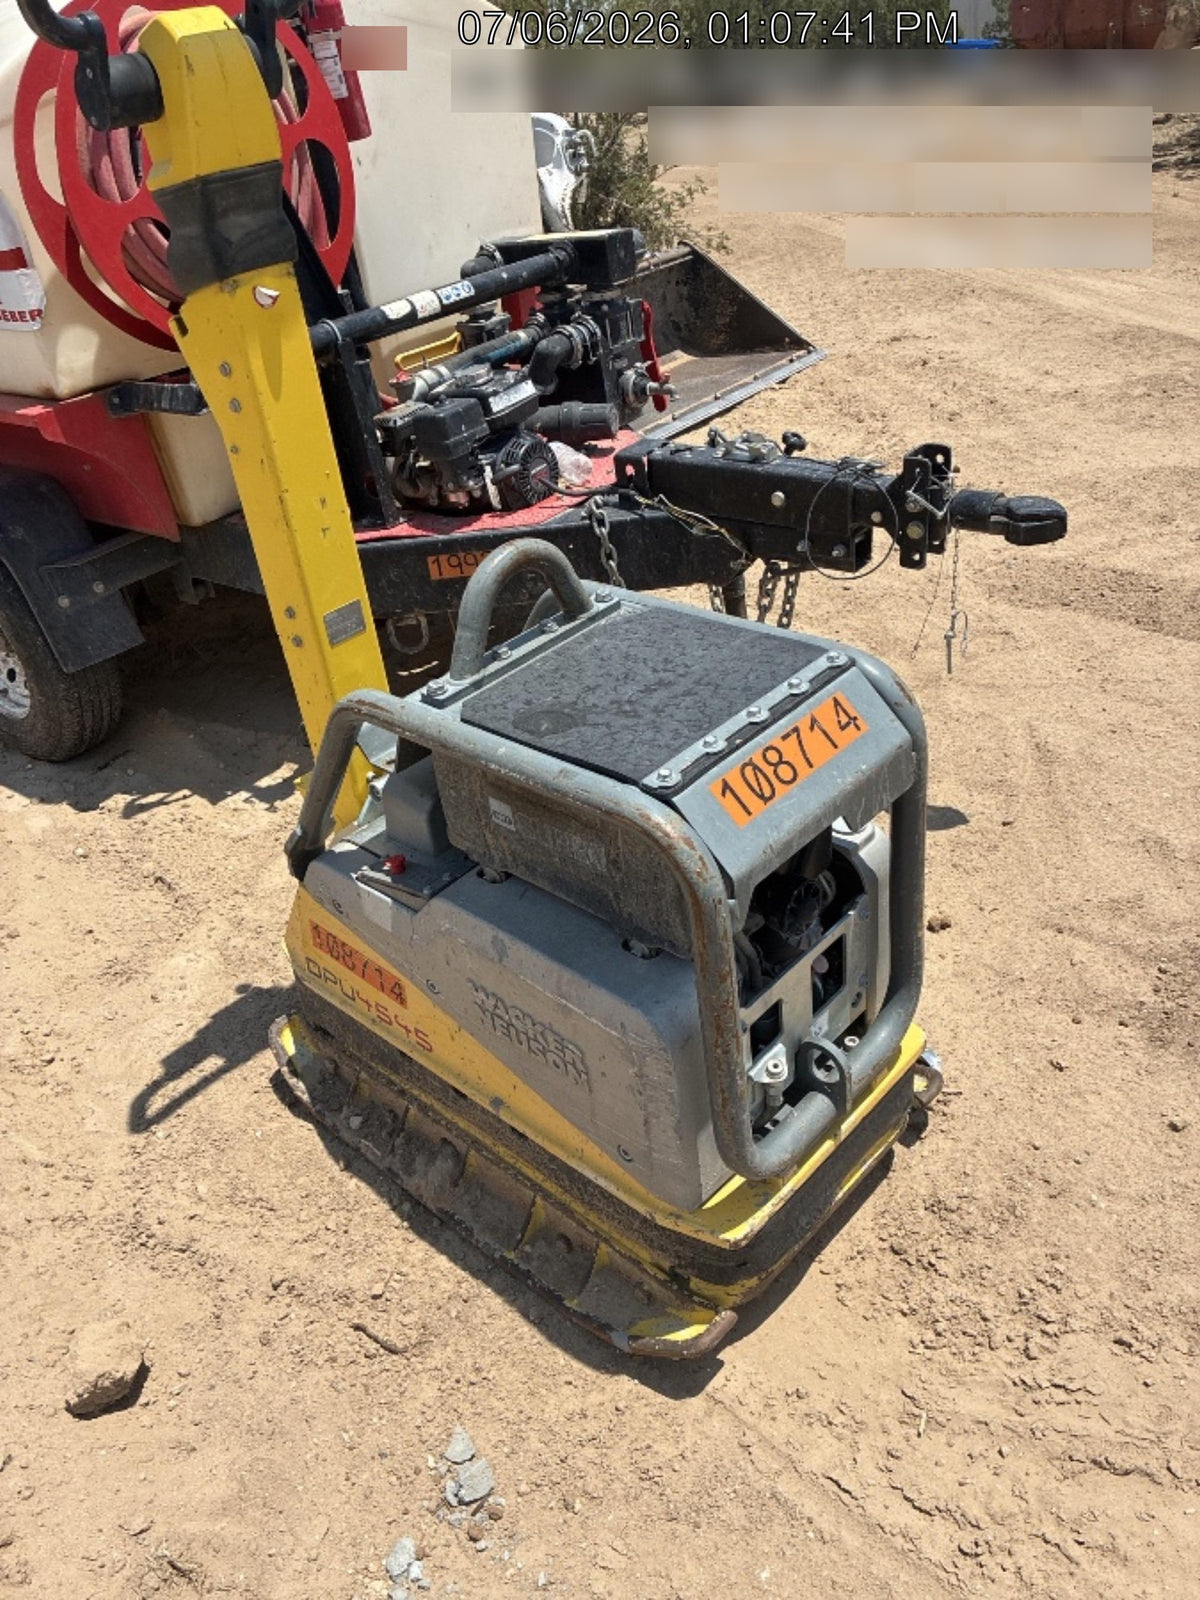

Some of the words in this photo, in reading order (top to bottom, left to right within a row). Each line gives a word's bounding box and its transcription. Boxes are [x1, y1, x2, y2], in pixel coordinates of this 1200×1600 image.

[0, 309, 43, 322] EBER
[431, 551, 492, 576] 199
[721, 696, 861, 816] 108714
[305, 957, 433, 1053] DPU4545
[466, 977, 585, 1069] WACKER
